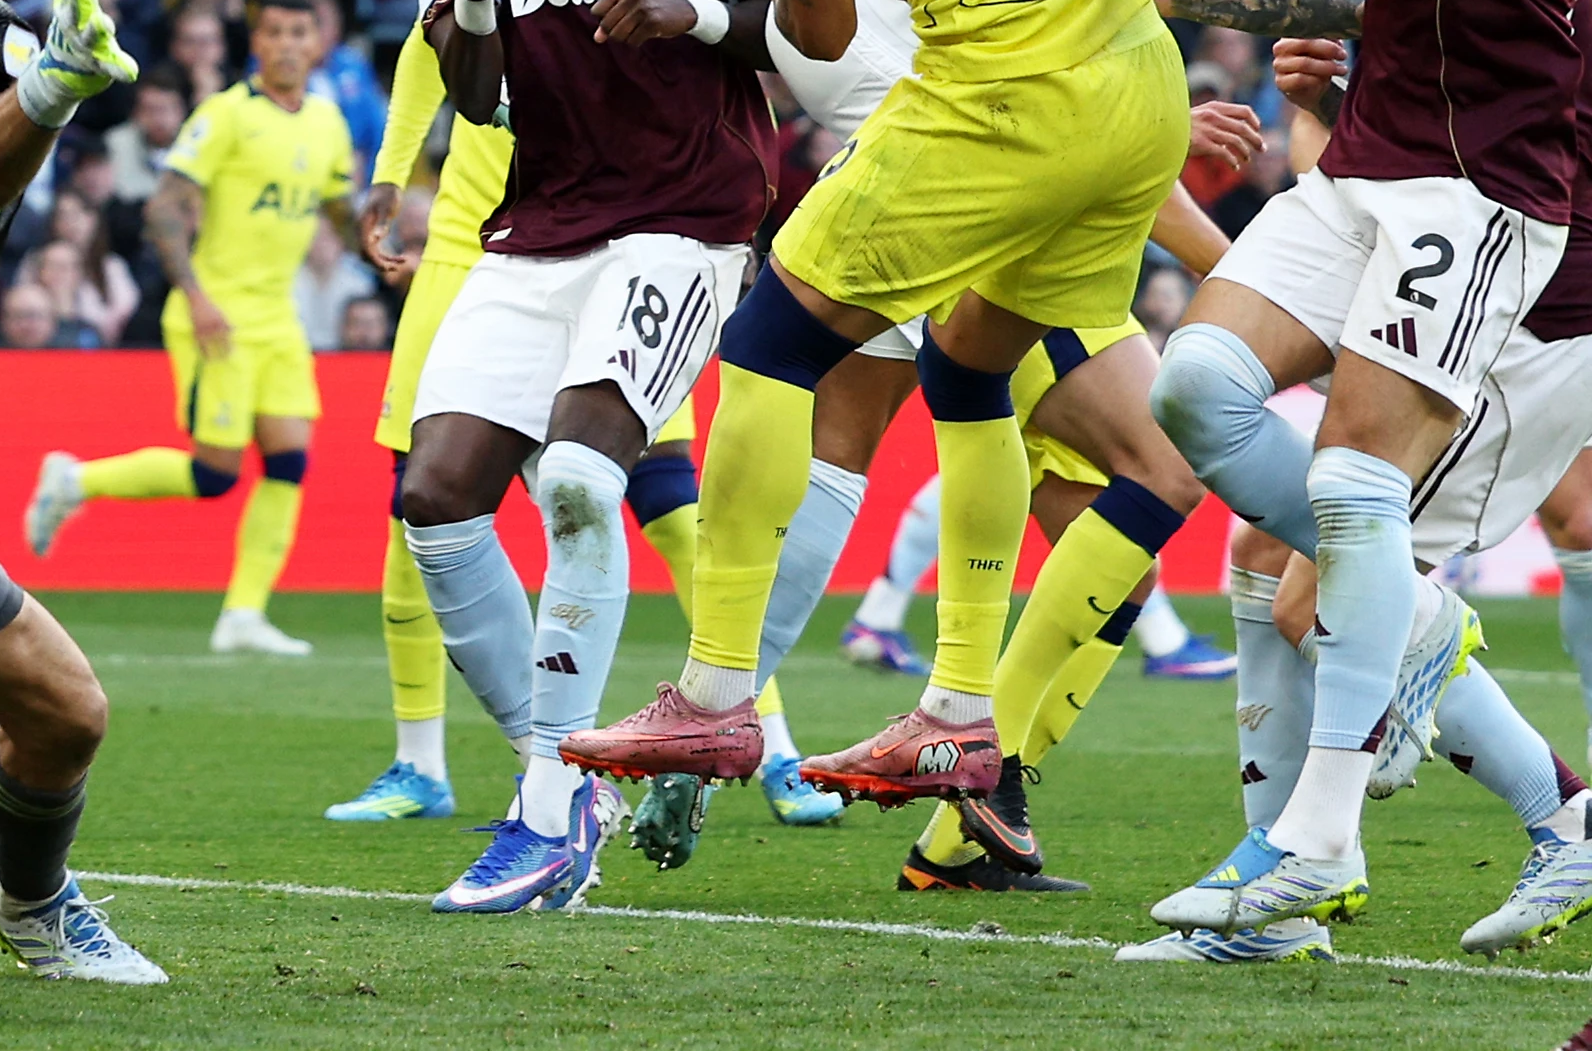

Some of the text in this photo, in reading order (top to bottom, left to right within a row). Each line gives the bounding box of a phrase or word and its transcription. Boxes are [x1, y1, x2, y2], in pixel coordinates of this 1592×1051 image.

[1395, 232, 1456, 312] 2
[616, 274, 669, 349] 18
[967, 558, 1004, 572] THFC
